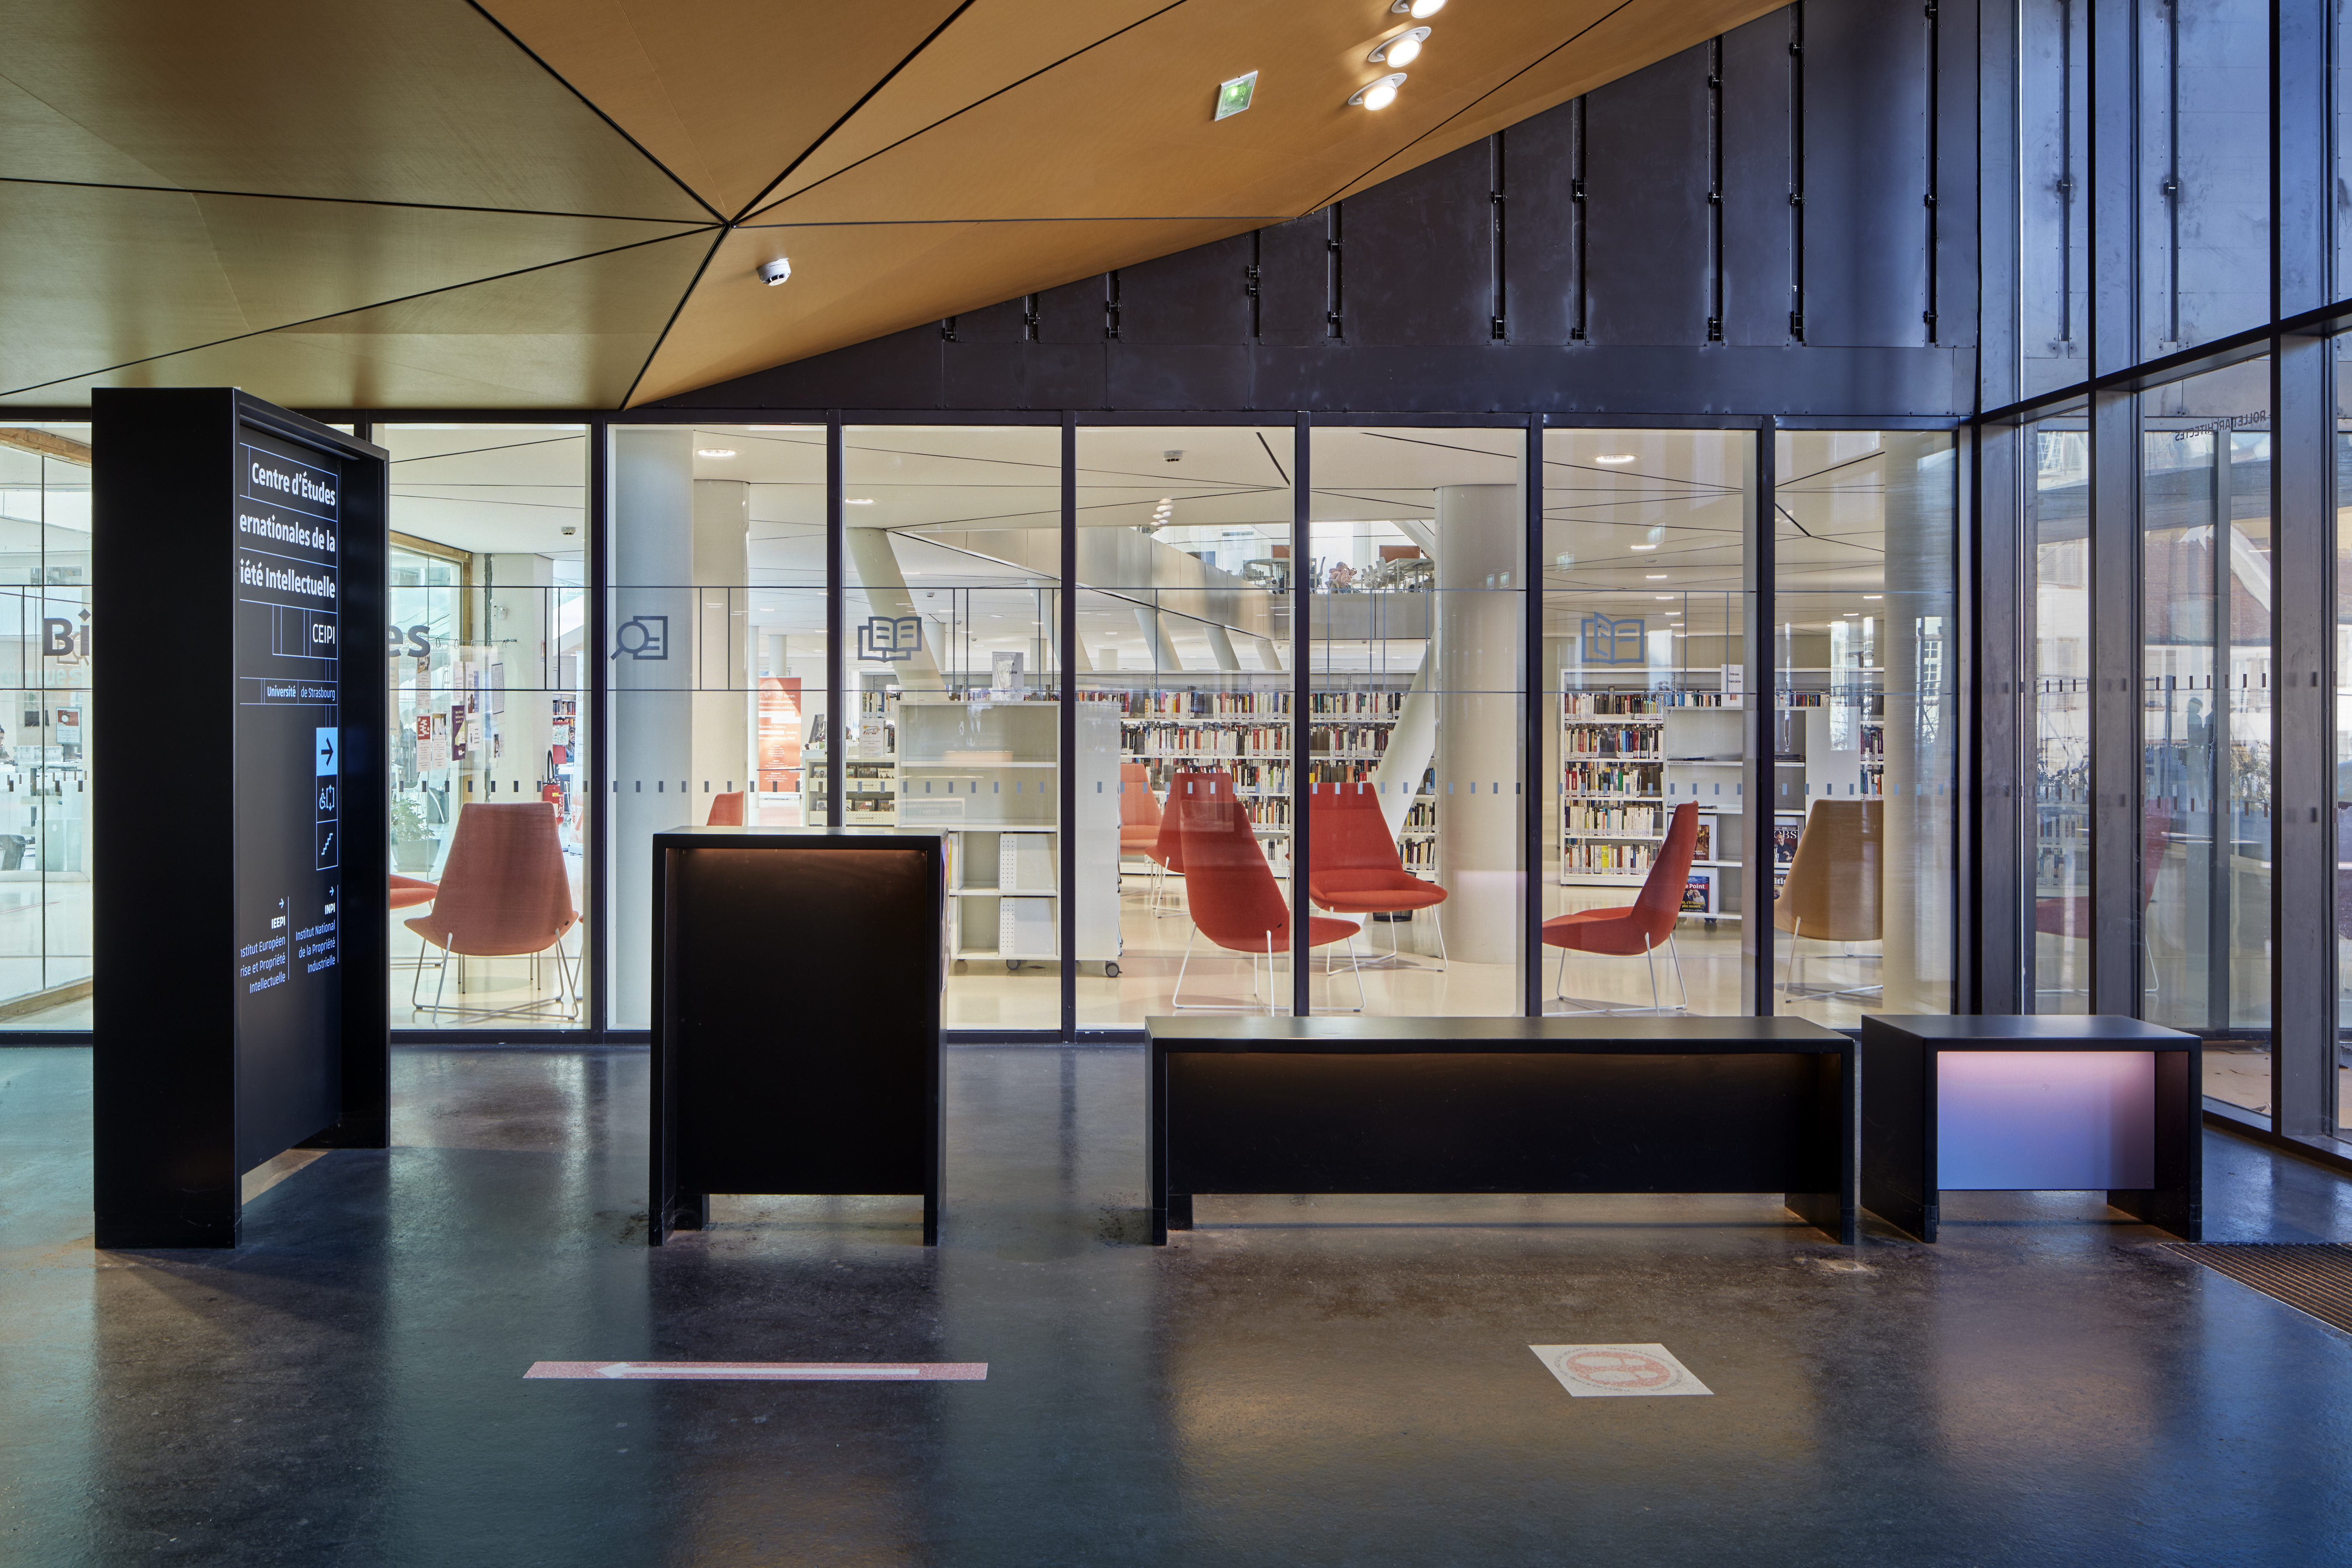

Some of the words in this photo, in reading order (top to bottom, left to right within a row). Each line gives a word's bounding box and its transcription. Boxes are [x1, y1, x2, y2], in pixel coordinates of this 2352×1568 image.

[252, 462, 290, 492] Centre
[292, 471, 335, 506] d’Études
[240, 514, 310, 546] ernationales
[312, 527, 325, 549] de
[327, 530, 335, 552] la
[266, 567, 335, 598] Intellectuelle
[312, 623, 335, 644] CEIPI
[267, 685, 296, 697] Université
[301, 686, 307, 698] de
[308, 687, 335, 701] Strasbourg
[325, 903, 335, 914] INPI
[271, 916, 285, 929] IEEPI
[296, 927, 314, 941] Institut
[315, 919, 335, 932] National
[259, 935, 285, 951] Européen
[299, 947, 305, 958] de
[307, 946, 311, 956] la
[312, 937, 335, 954] Propriété
[240, 965, 251, 977] rise
[252, 962, 258, 973] et
[260, 952, 286, 971] Propriété
[307, 955, 335, 973] Industrielle
[249, 971, 286, 993] Intellectuelle
